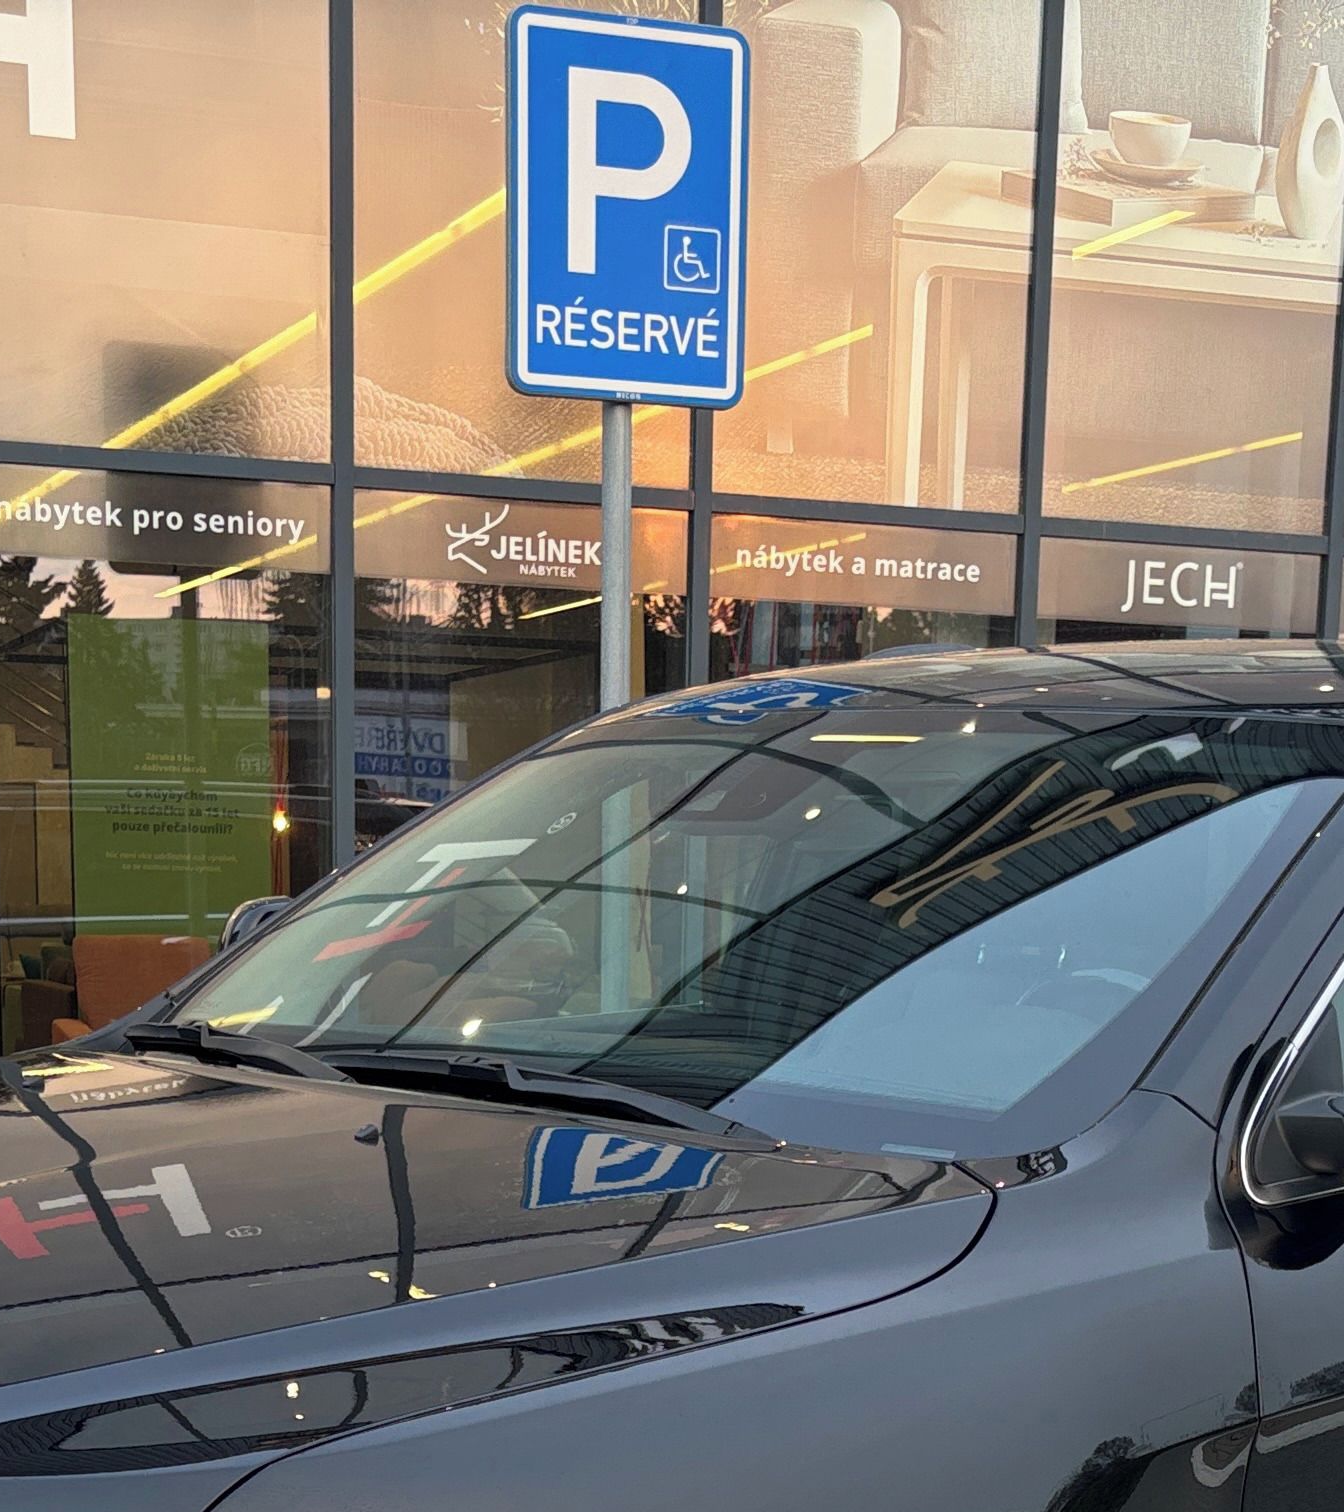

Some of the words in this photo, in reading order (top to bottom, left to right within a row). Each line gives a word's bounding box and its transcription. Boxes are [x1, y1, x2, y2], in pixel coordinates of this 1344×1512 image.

[568, 66, 692, 274] P
[536, 297, 720, 359] RÉSERVÉ
[133, 509, 184, 536] pro
[193, 511, 305, 544] seniory
[490, 531, 601, 566] JELÍNEK
[735, 545, 844, 577] nábytek
[851, 556, 866, 575] a
[874, 558, 981, 583] matrace
[519, 562, 577, 578] NÁBYTEK
[112, 821, 150, 834] pouze
